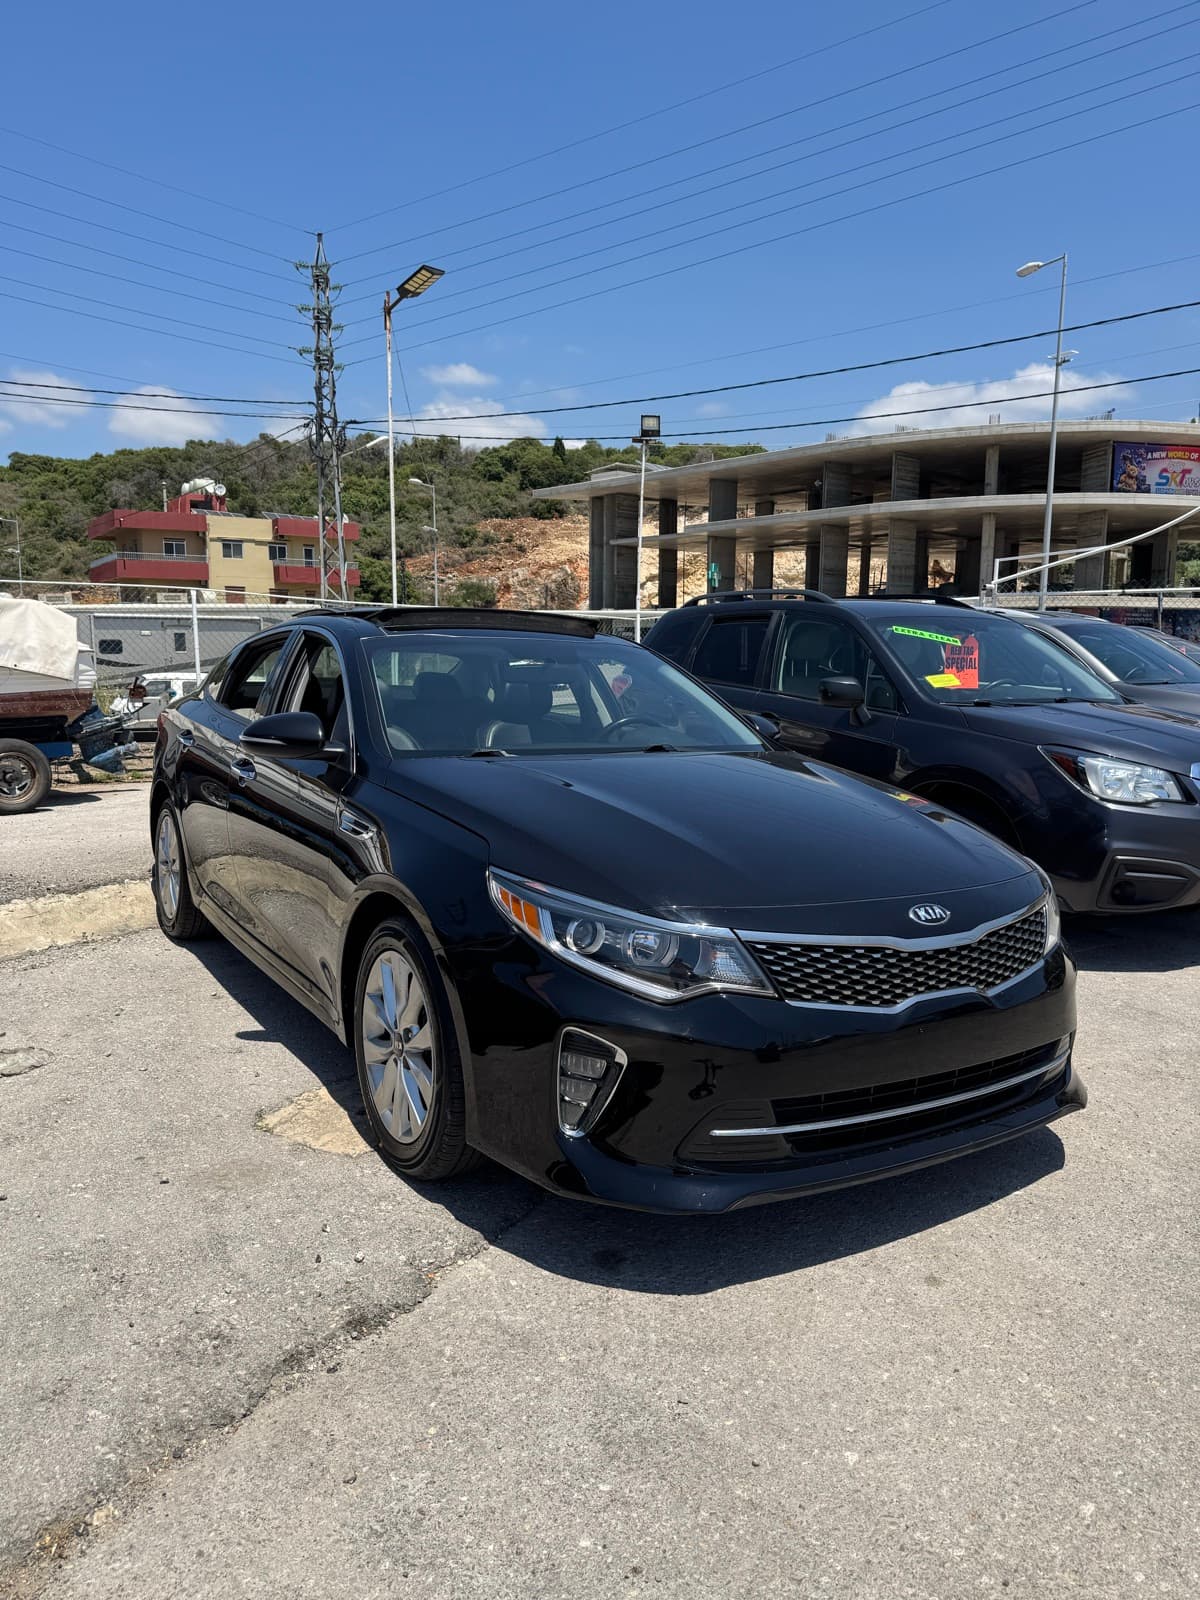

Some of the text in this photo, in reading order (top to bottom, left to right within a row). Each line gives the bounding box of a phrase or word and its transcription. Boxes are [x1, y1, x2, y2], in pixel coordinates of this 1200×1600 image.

[1152, 451, 1167, 459] NEW
[1168, 451, 1190, 459] WORLD
[1190, 452, 1199, 460] OF
[894, 627, 958, 643] EXTRA CLEAN
[950, 646, 974, 655] RED TAG
[945, 657, 977, 669] SPECIAL
[914, 906, 946, 920] KIA
